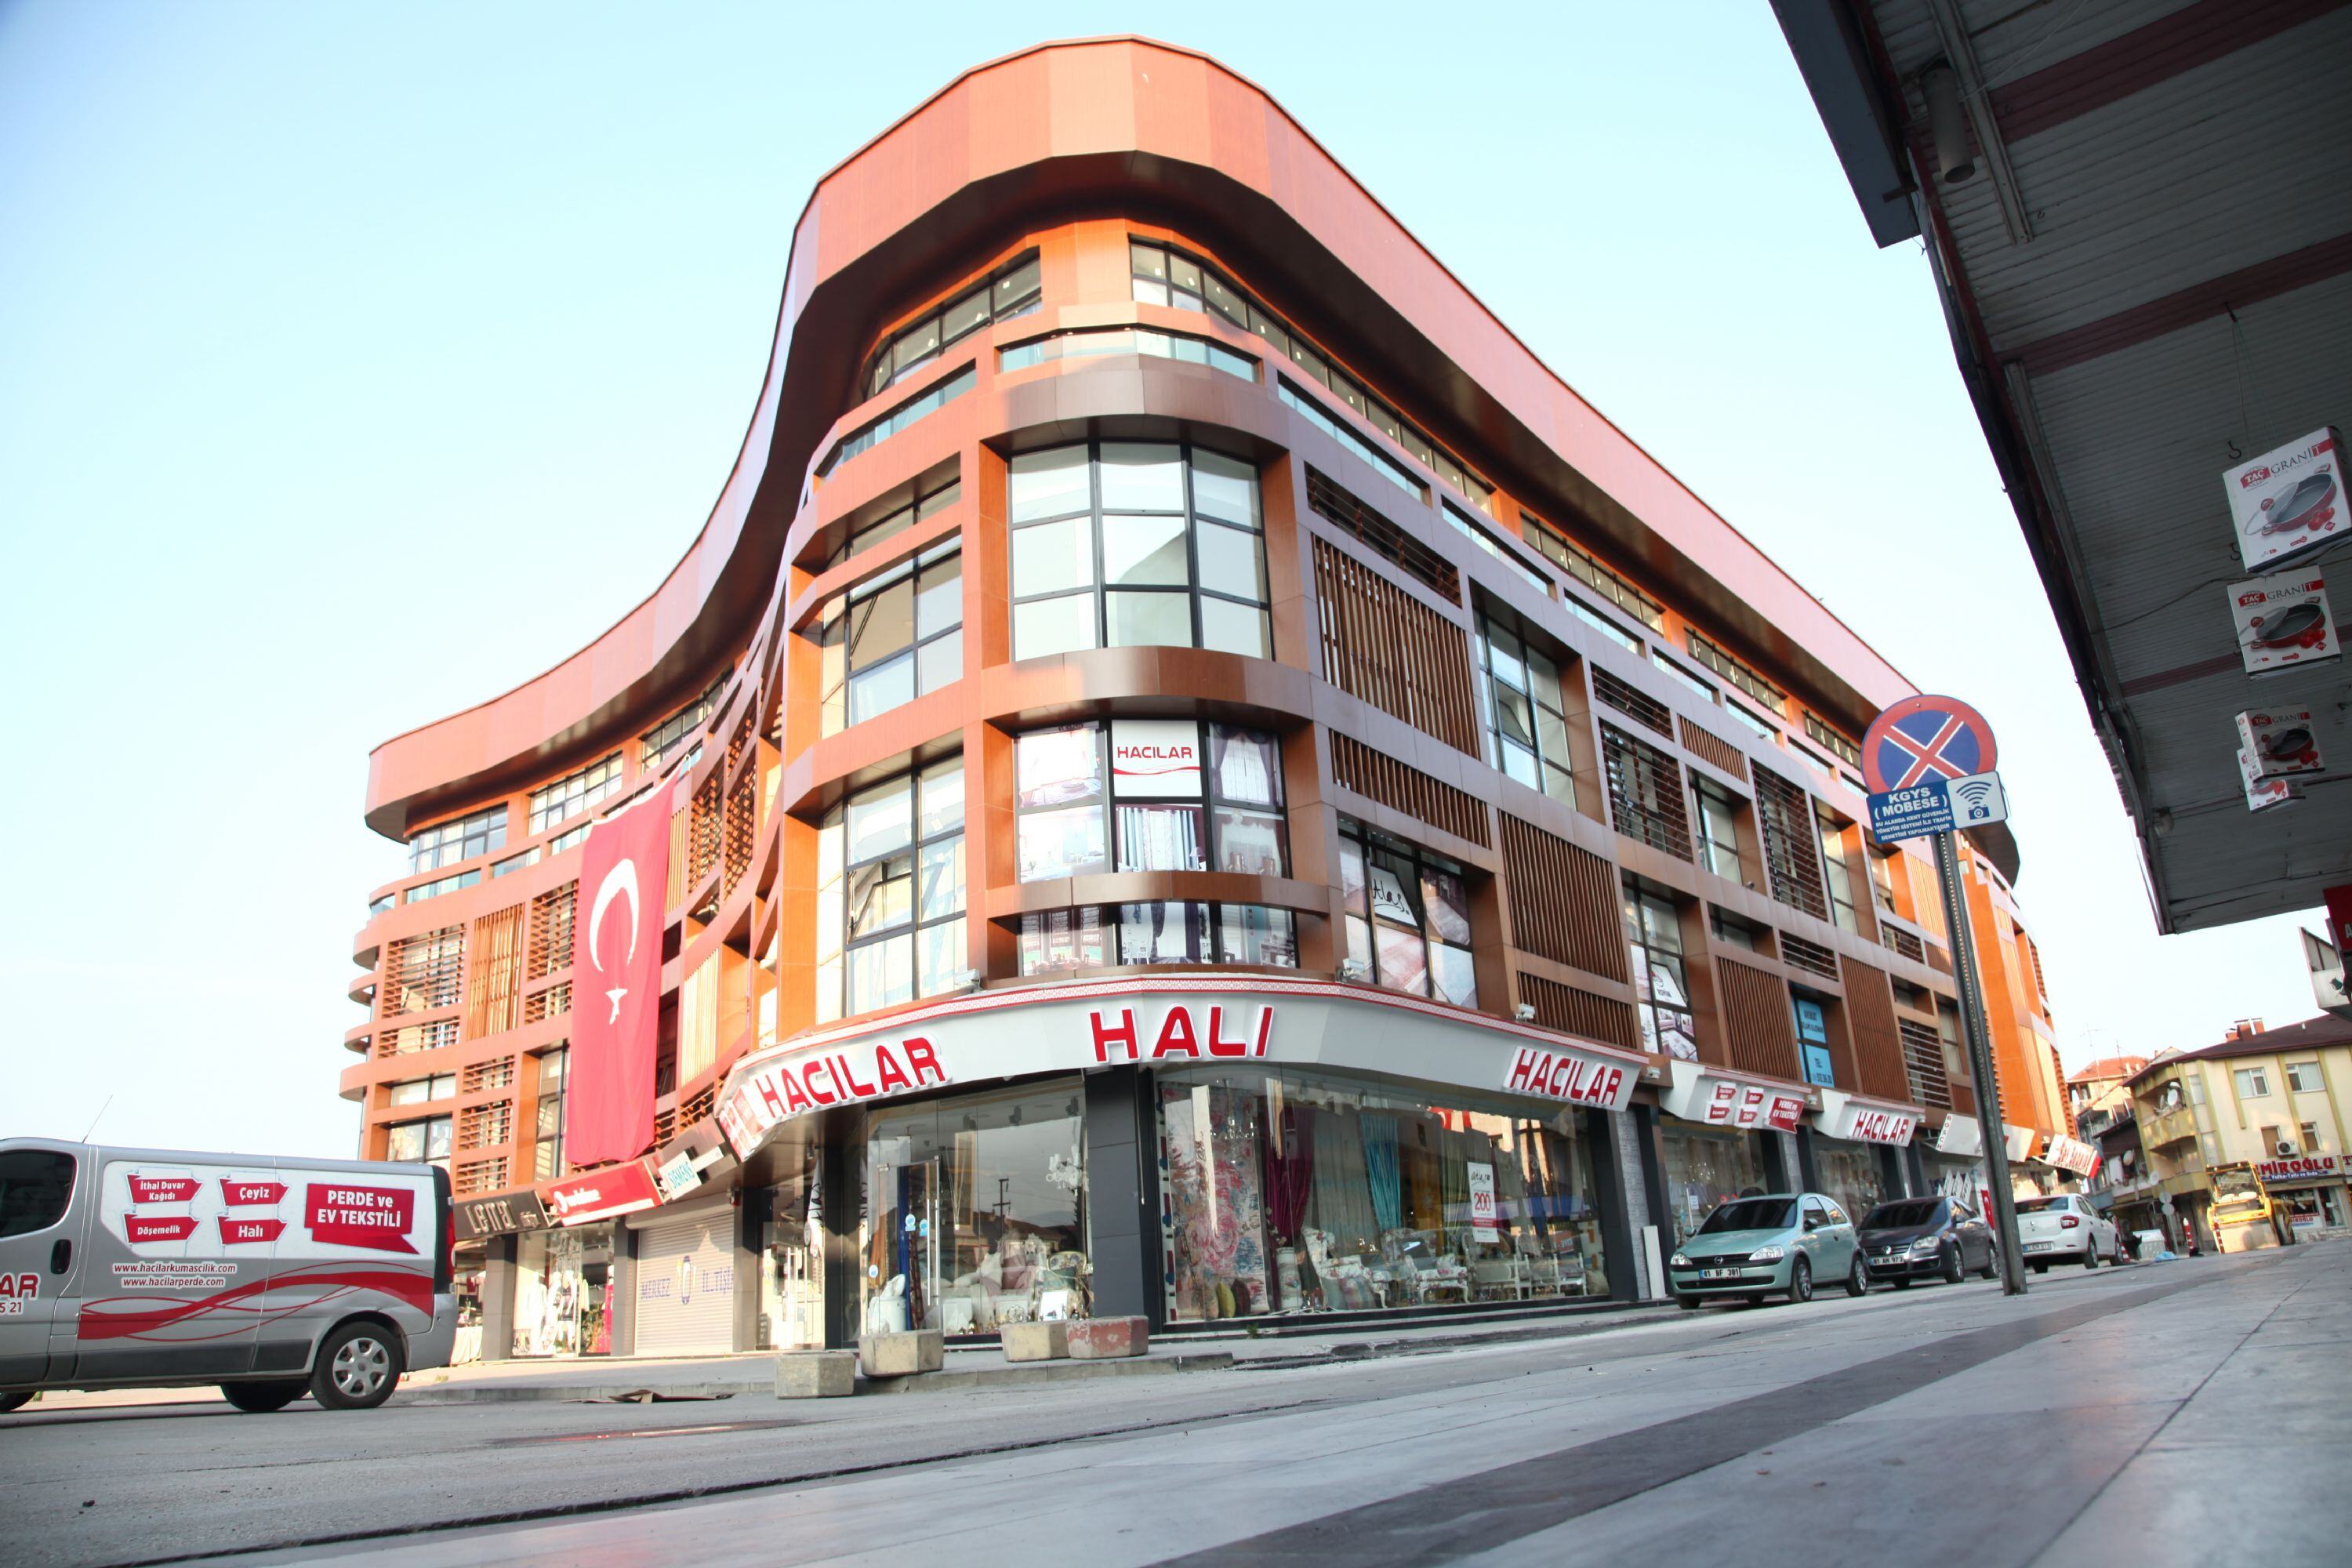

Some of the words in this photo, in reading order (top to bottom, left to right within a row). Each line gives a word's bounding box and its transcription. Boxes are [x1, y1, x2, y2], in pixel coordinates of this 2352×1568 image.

[2245, 470, 2265, 484] TAÇ
[2242, 594, 2261, 604] TAÇ
[1116, 746, 1192, 759] HACILAR
[1889, 787, 1930, 804] KGYS
[1882, 796, 1940, 816] MOBESE
[1090, 1006, 1273, 1062] HALI
[755, 1037, 946, 1118] HACILAR
[1510, 1048, 1623, 1105] HACILAR
[1853, 1111, 1909, 1143] HACILAR
[140, 1181, 159, 1190] İthal
[149, 1192, 176, 1202] Kağıdı
[239, 1187, 269, 1200] Çeyiz
[327, 1190, 374, 1207] PERDE
[377, 1196, 394, 1207] ve
[1474, 1192, 1491, 1211] 200
[317, 1208, 336, 1224] EV
[339, 1210, 401, 1227] TEKSTİLİ
[137, 1227, 180, 1236] Döşemelik
[238, 1225, 263, 1237] Halı
[114, 1263, 236, 1272] www.hacilarkumascilik.com
[123, 1277, 224, 1287] www.hacilarperde.com
